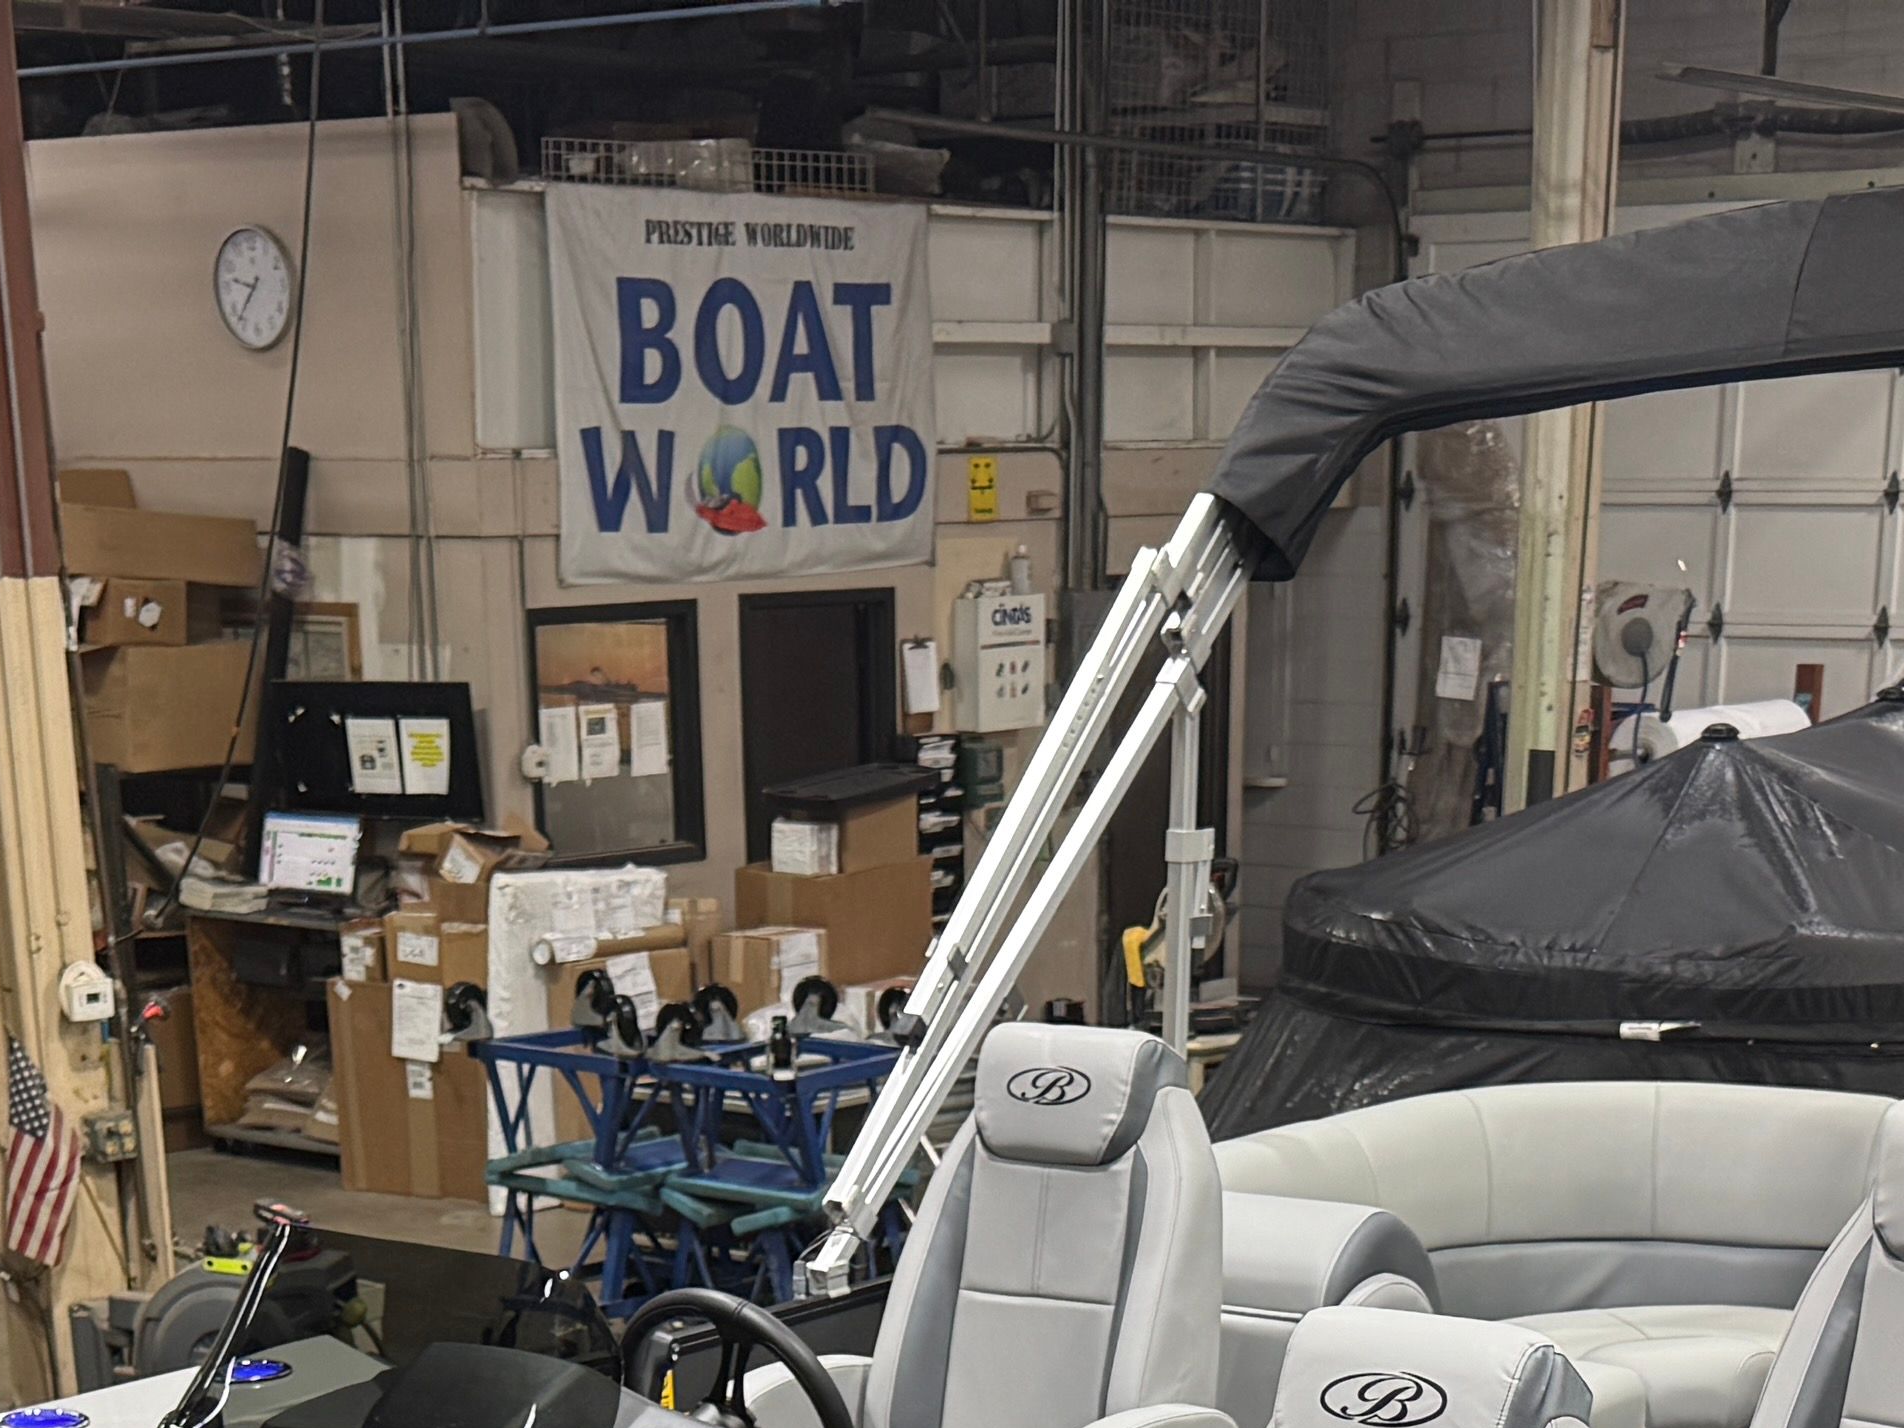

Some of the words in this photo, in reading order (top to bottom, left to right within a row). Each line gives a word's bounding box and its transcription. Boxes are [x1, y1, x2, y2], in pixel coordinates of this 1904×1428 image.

[644, 219, 736, 246] PRESTIGE
[743, 221, 856, 251] WORLDWIDE
[616, 276, 892, 406] BOAT
